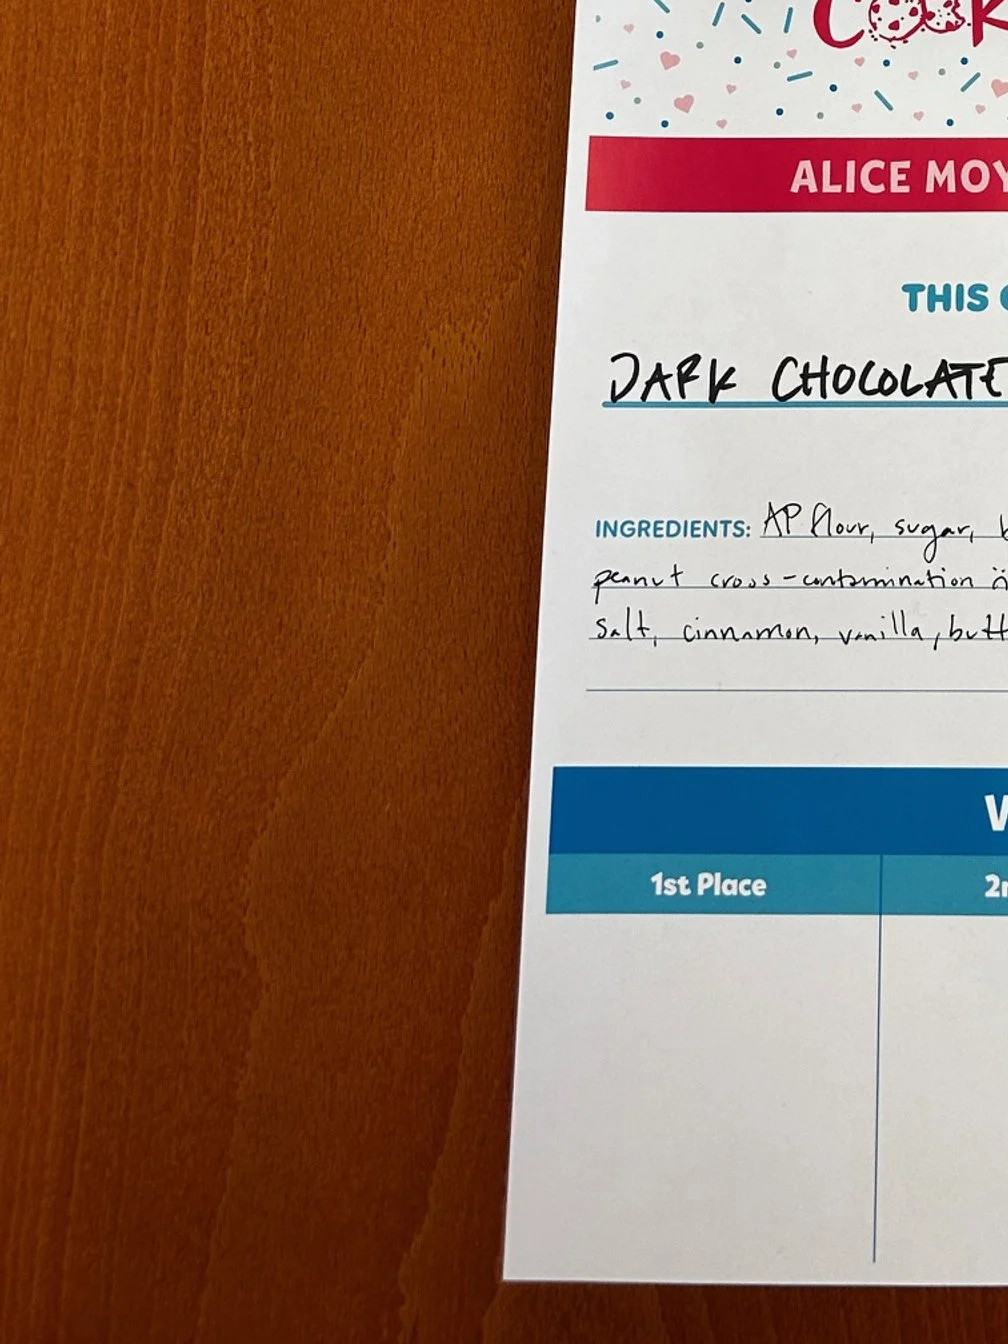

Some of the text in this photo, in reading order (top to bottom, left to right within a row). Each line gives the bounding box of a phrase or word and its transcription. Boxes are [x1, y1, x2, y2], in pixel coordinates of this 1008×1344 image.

[790, 158, 910, 195] ALICE
[902, 283, 989, 312] THIS
[611, 353, 736, 403] DARK
[595, 519, 751, 539] INGREDIENTS:
[763, 501, 802, 536] AP
[810, 502, 875, 543] flour,
[895, 518, 974, 563] sugar,
[593, 563, 684, 604] peanut
[683, 617, 819, 644] cinnamon,
[649, 871, 767, 899] 1st Place
